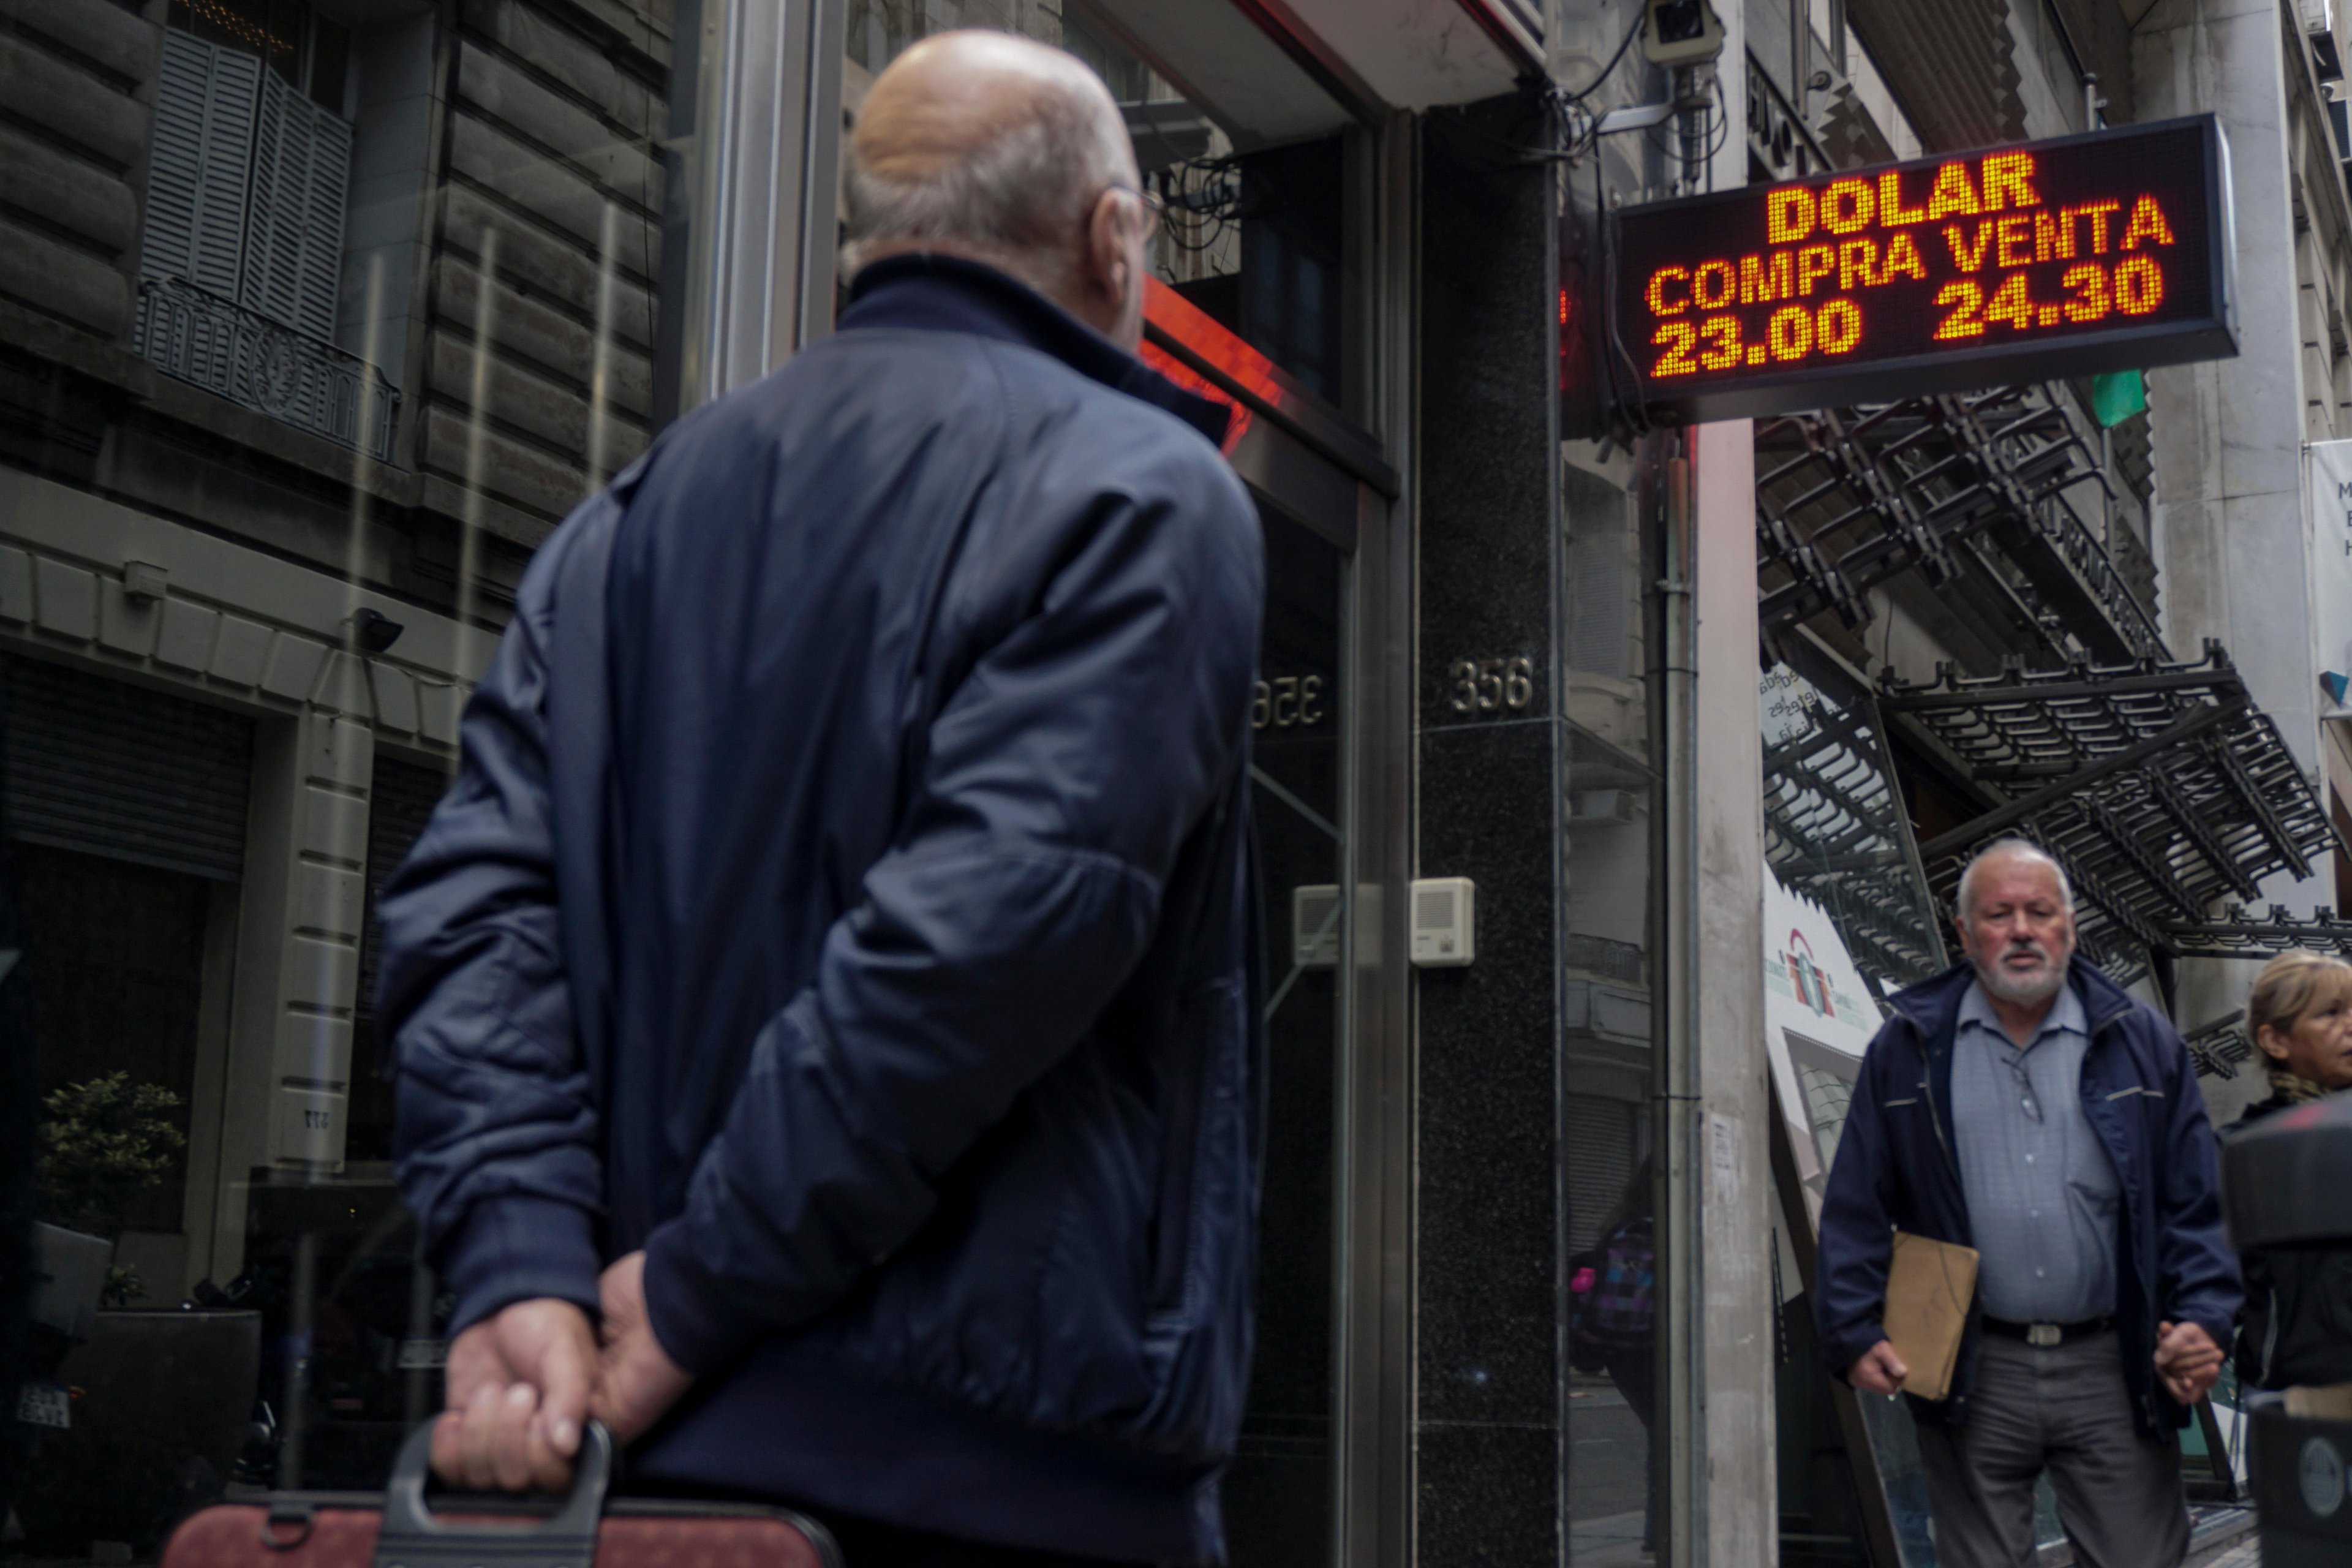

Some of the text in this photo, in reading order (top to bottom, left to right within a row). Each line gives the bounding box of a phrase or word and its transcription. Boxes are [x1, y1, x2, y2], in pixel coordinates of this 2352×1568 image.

[1767, 151, 2041, 244] DOLAR
[1645, 195, 2174, 317] COMPRA VENTA
[1649, 254, 2163, 378] 23.00 24.30
[1452, 657, 1532, 713] 356
